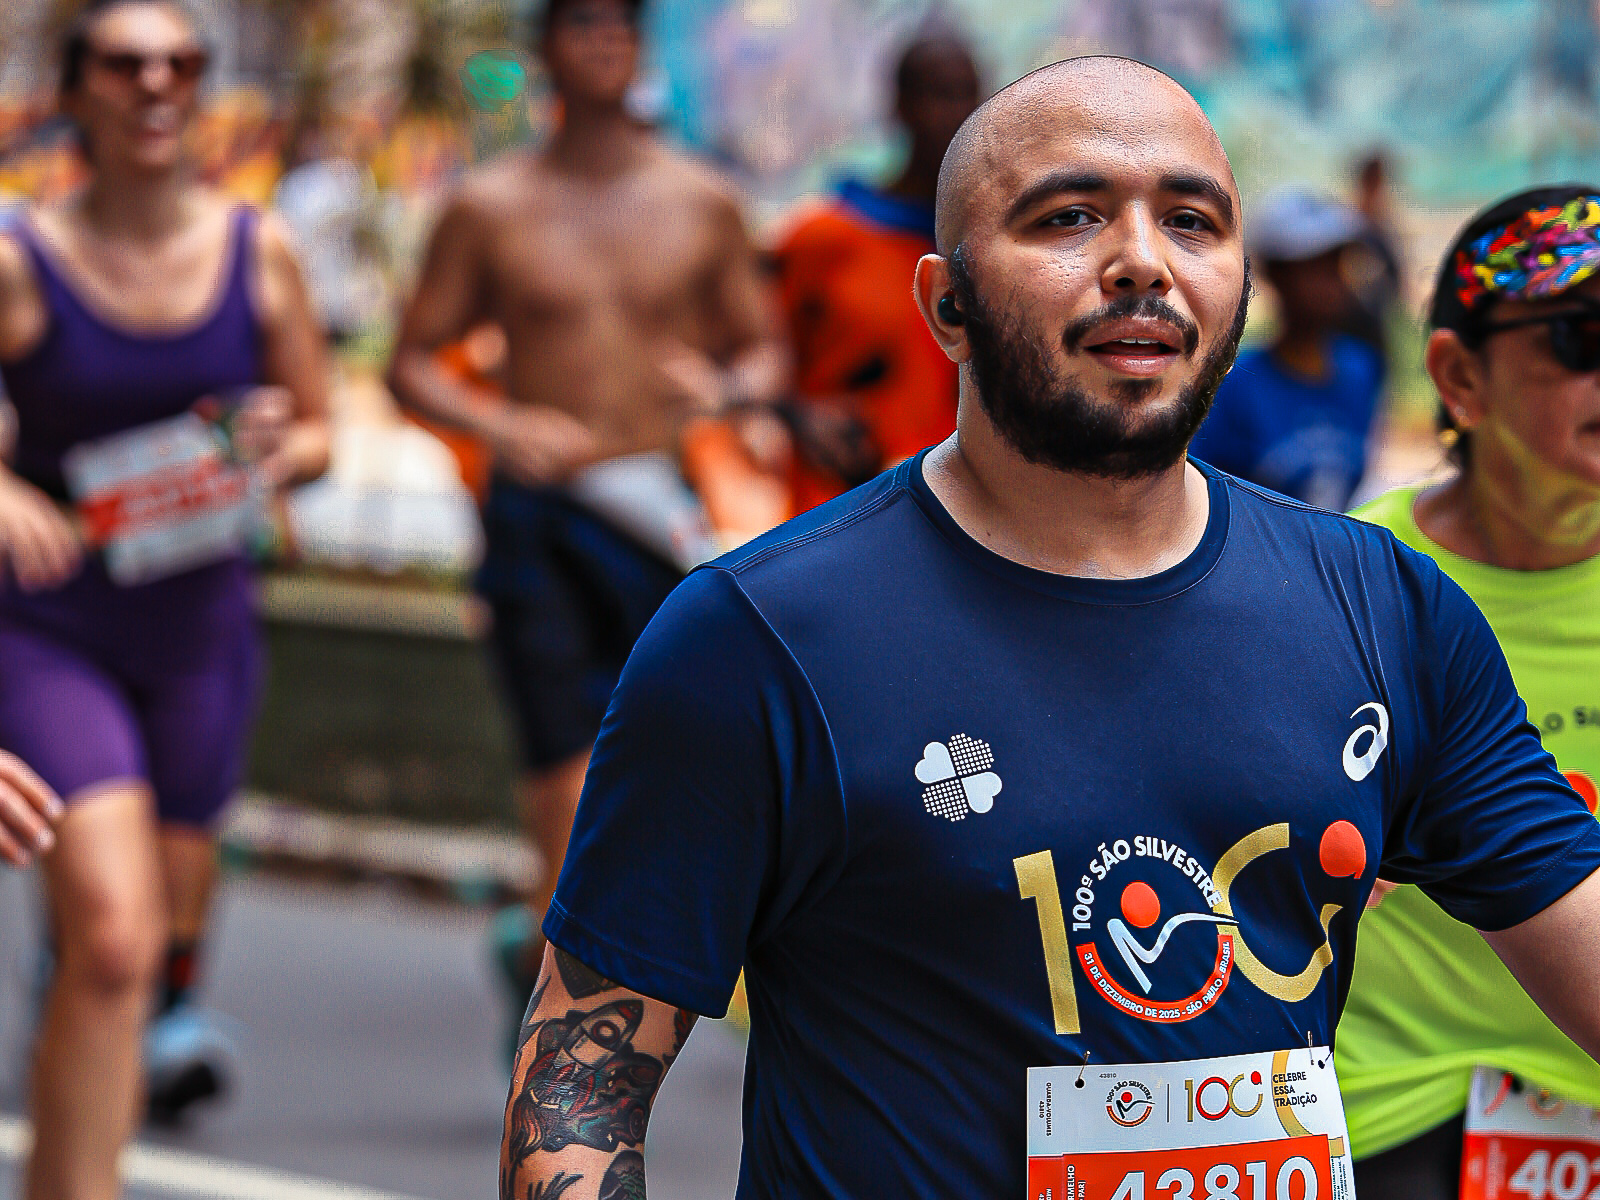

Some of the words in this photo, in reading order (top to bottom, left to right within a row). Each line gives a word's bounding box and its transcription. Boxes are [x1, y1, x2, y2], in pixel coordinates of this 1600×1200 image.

[1089, 841, 1131, 880] SÃO
[1133, 835, 1223, 909] SILVESTRE
[1083, 952, 1095, 965] 31
[1089, 965, 1103, 981] DE
[1097, 978, 1144, 1014] DEZEMBRO
[1144, 1007, 1158, 1018] DE
[1158, 1008, 1181, 1019] 2025
[1185, 1001, 1203, 1015] SÃO
[1202, 978, 1223, 1005] PAULO
[1218, 941, 1230, 973] BRASIL
[1272, 1071, 1307, 1083] CELEBRE
[1274, 1085, 1296, 1096] ESSA
[1274, 1092, 1318, 1108] TRADIÇÃO
